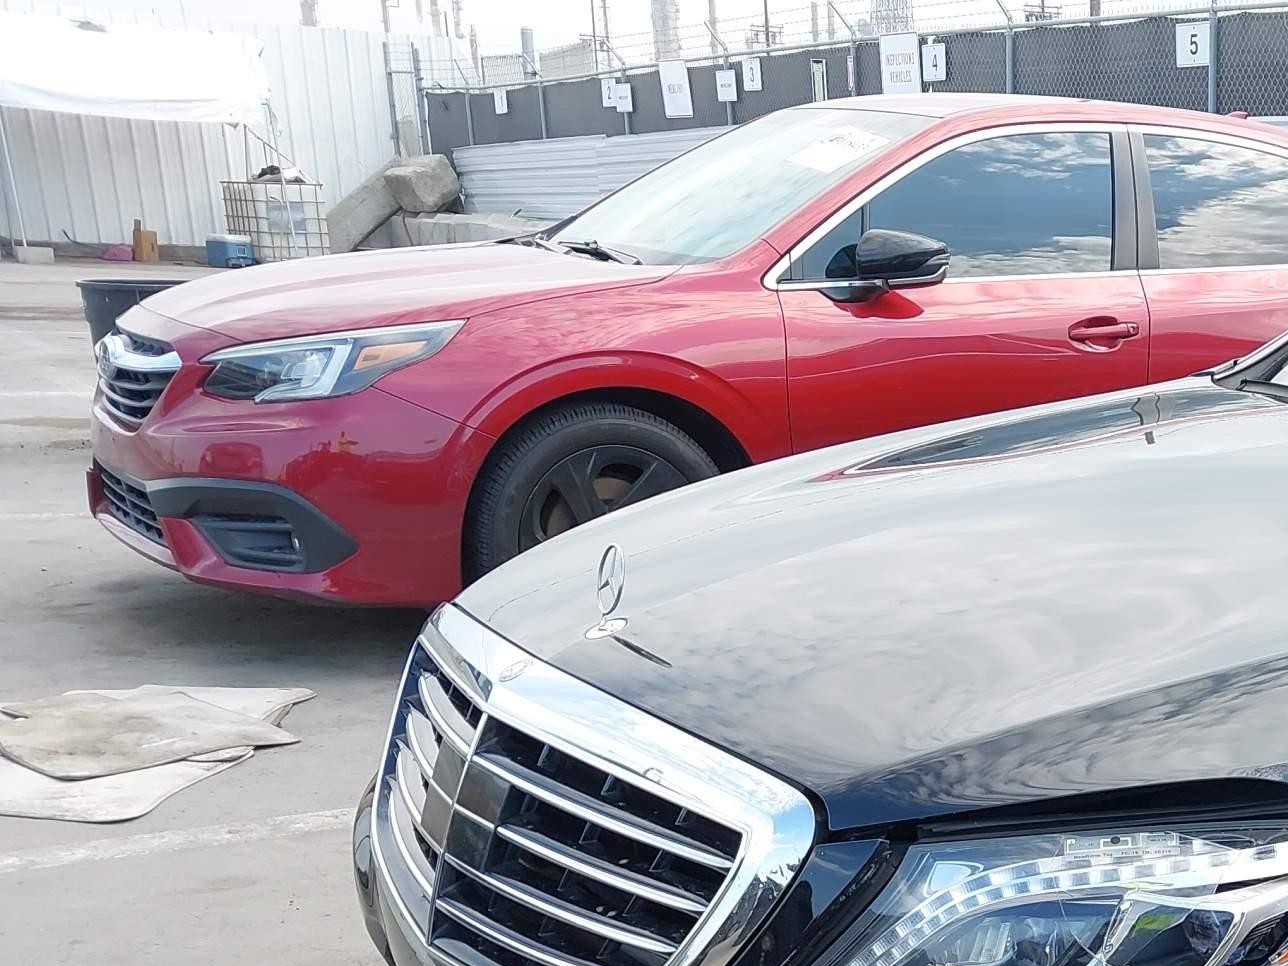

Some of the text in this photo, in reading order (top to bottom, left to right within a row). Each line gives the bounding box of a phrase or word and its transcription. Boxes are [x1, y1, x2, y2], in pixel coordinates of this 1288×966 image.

[1190, 34, 1198, 55] 5
[932, 54, 938, 72] 4
[749, 66, 755, 82] 3
[606, 86, 612, 99] 2
